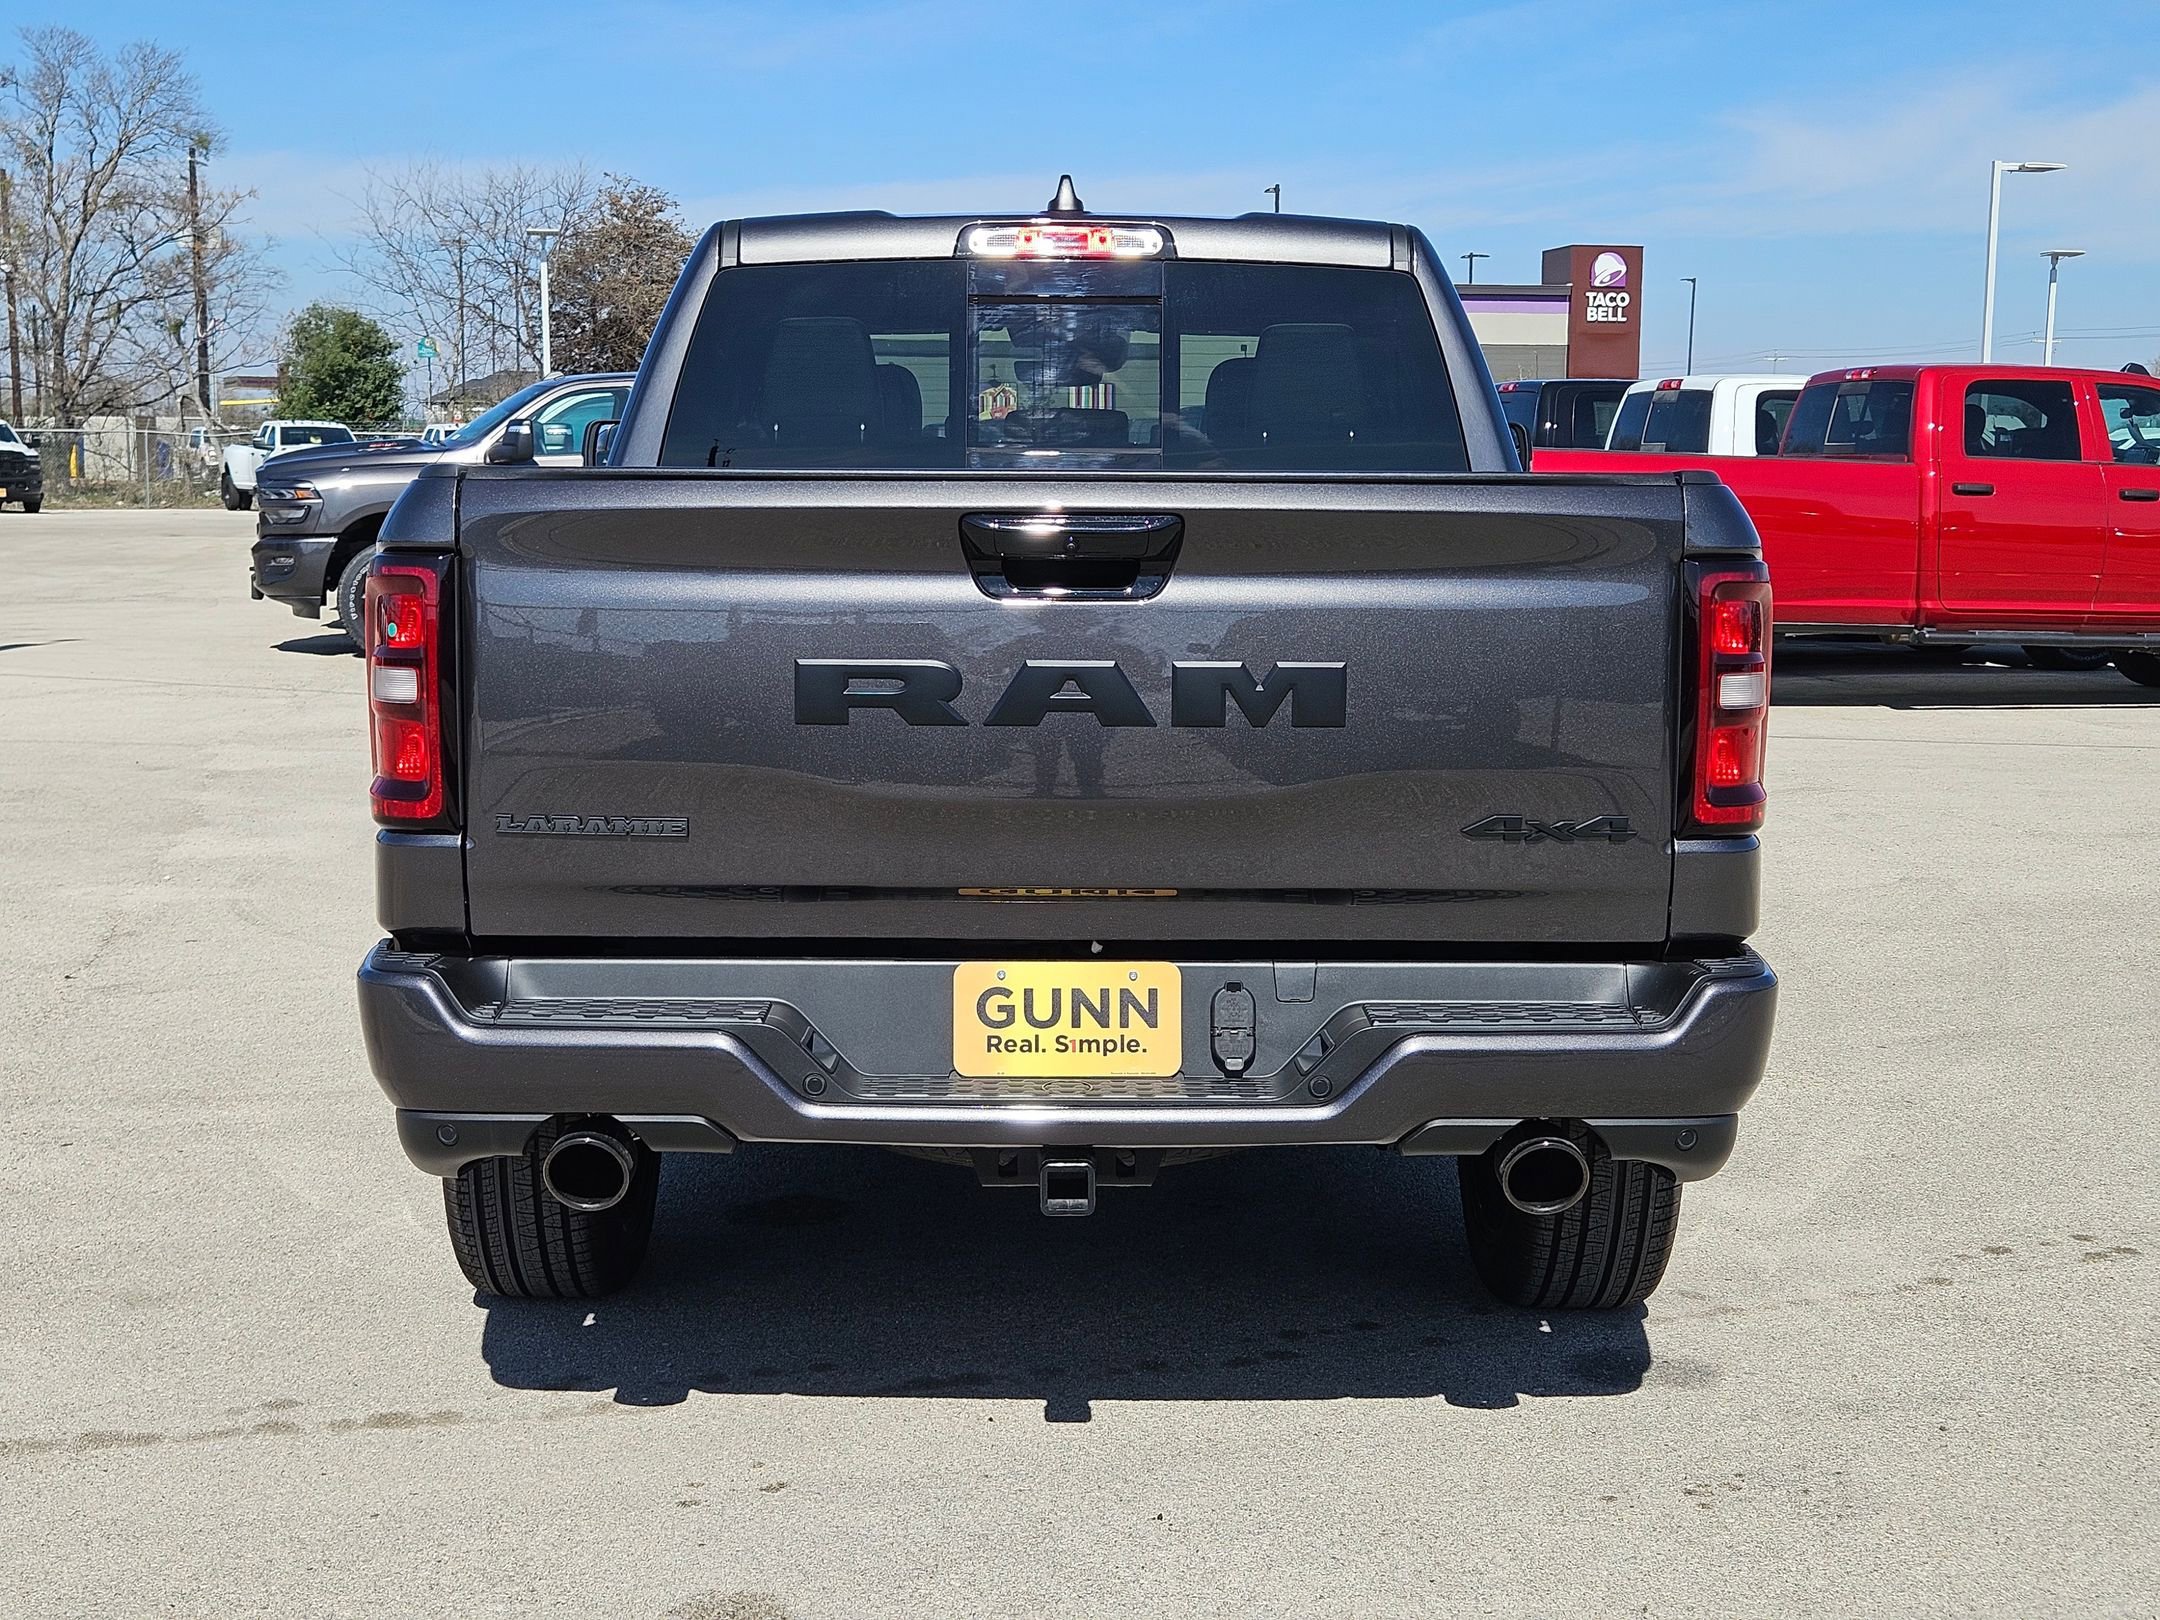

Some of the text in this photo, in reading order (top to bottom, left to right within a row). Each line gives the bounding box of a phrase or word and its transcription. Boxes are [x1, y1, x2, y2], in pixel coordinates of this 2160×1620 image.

[1585, 291, 1631, 307] TACO
[1586, 306, 1628, 322] BELL
[794, 658, 1347, 728] RAM
[495, 813, 690, 838] LARAMIE
[1460, 814, 1638, 842] 4x4
[976, 986, 1158, 1029] GUNN
[986, 1034, 1047, 1053] Real.
